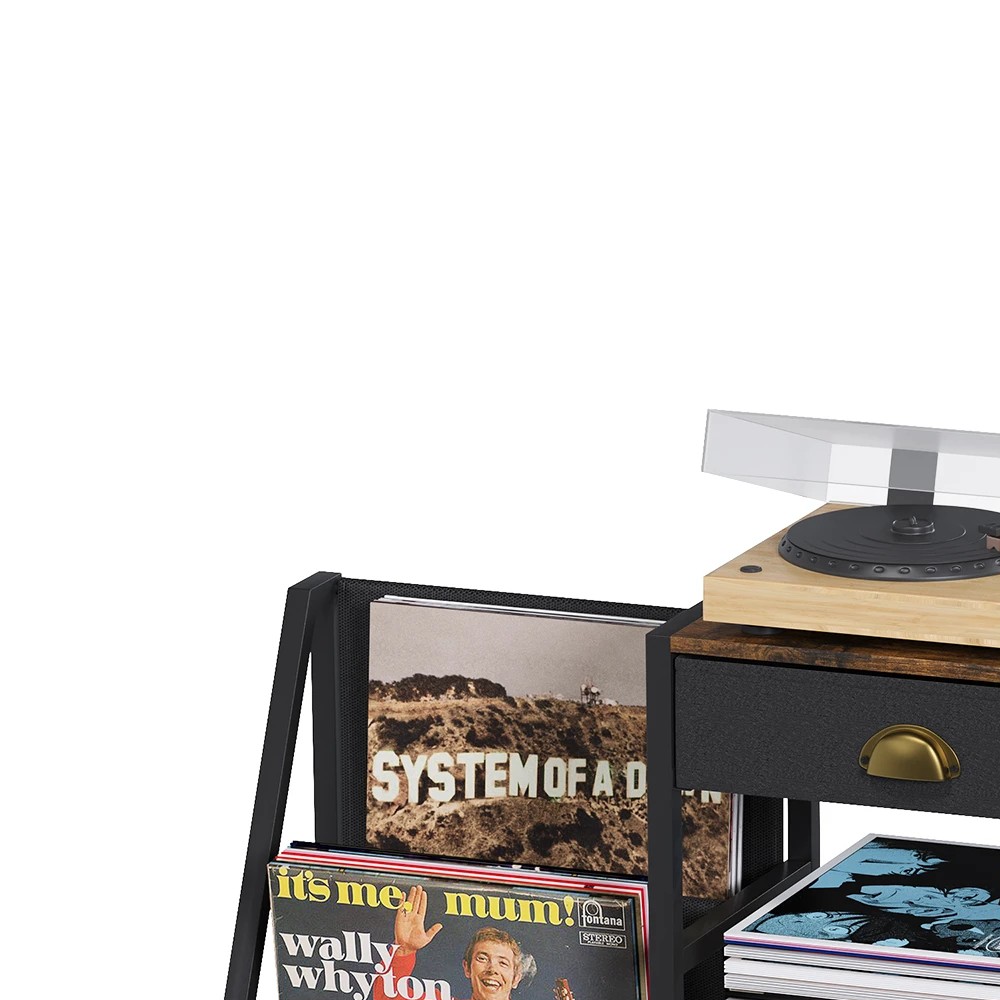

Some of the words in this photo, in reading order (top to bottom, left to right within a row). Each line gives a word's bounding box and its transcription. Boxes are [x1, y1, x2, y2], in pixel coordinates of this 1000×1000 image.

[372, 750, 539, 803] SYSTEM
[544, 757, 587, 797] OF
[592, 760, 614, 797] A
[276, 866, 330, 902] it's
[445, 890, 575, 927] mum!
[581, 906, 623, 927] fontana
[279, 930, 401, 974] wally
[583, 932, 623, 944] STEREO
